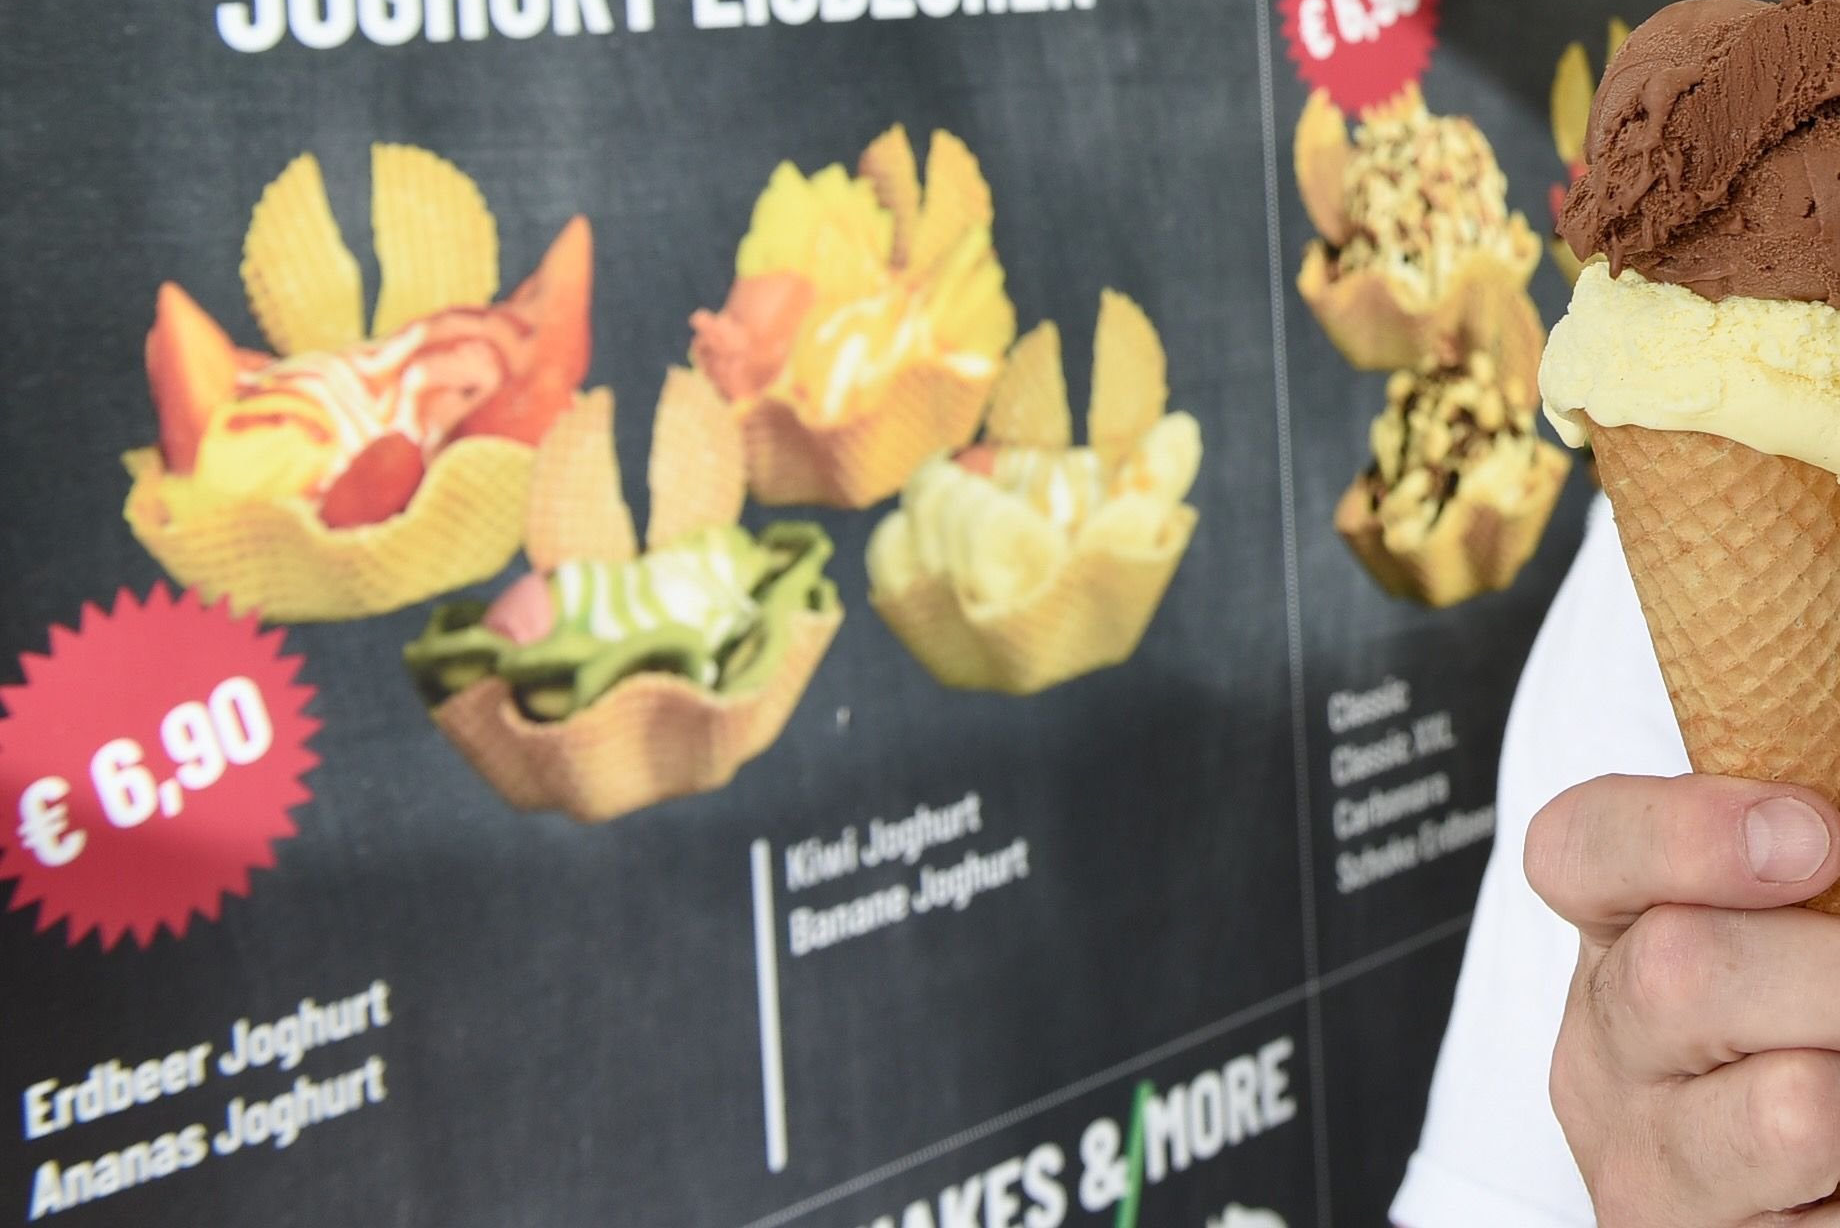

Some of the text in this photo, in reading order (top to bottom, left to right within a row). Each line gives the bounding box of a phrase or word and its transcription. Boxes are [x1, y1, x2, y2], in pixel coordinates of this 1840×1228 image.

[17, 675, 274, 867] € 6,90
[860, 799, 983, 867] Joghurt
[911, 844, 1030, 912] Joghurt
[22, 979, 393, 1141] Erdbeer Joghurt
[28, 1055, 389, 1222] Ananas Joghurt
[1078, 1117, 1131, 1213] &
[1143, 1034, 1296, 1184] MORE
